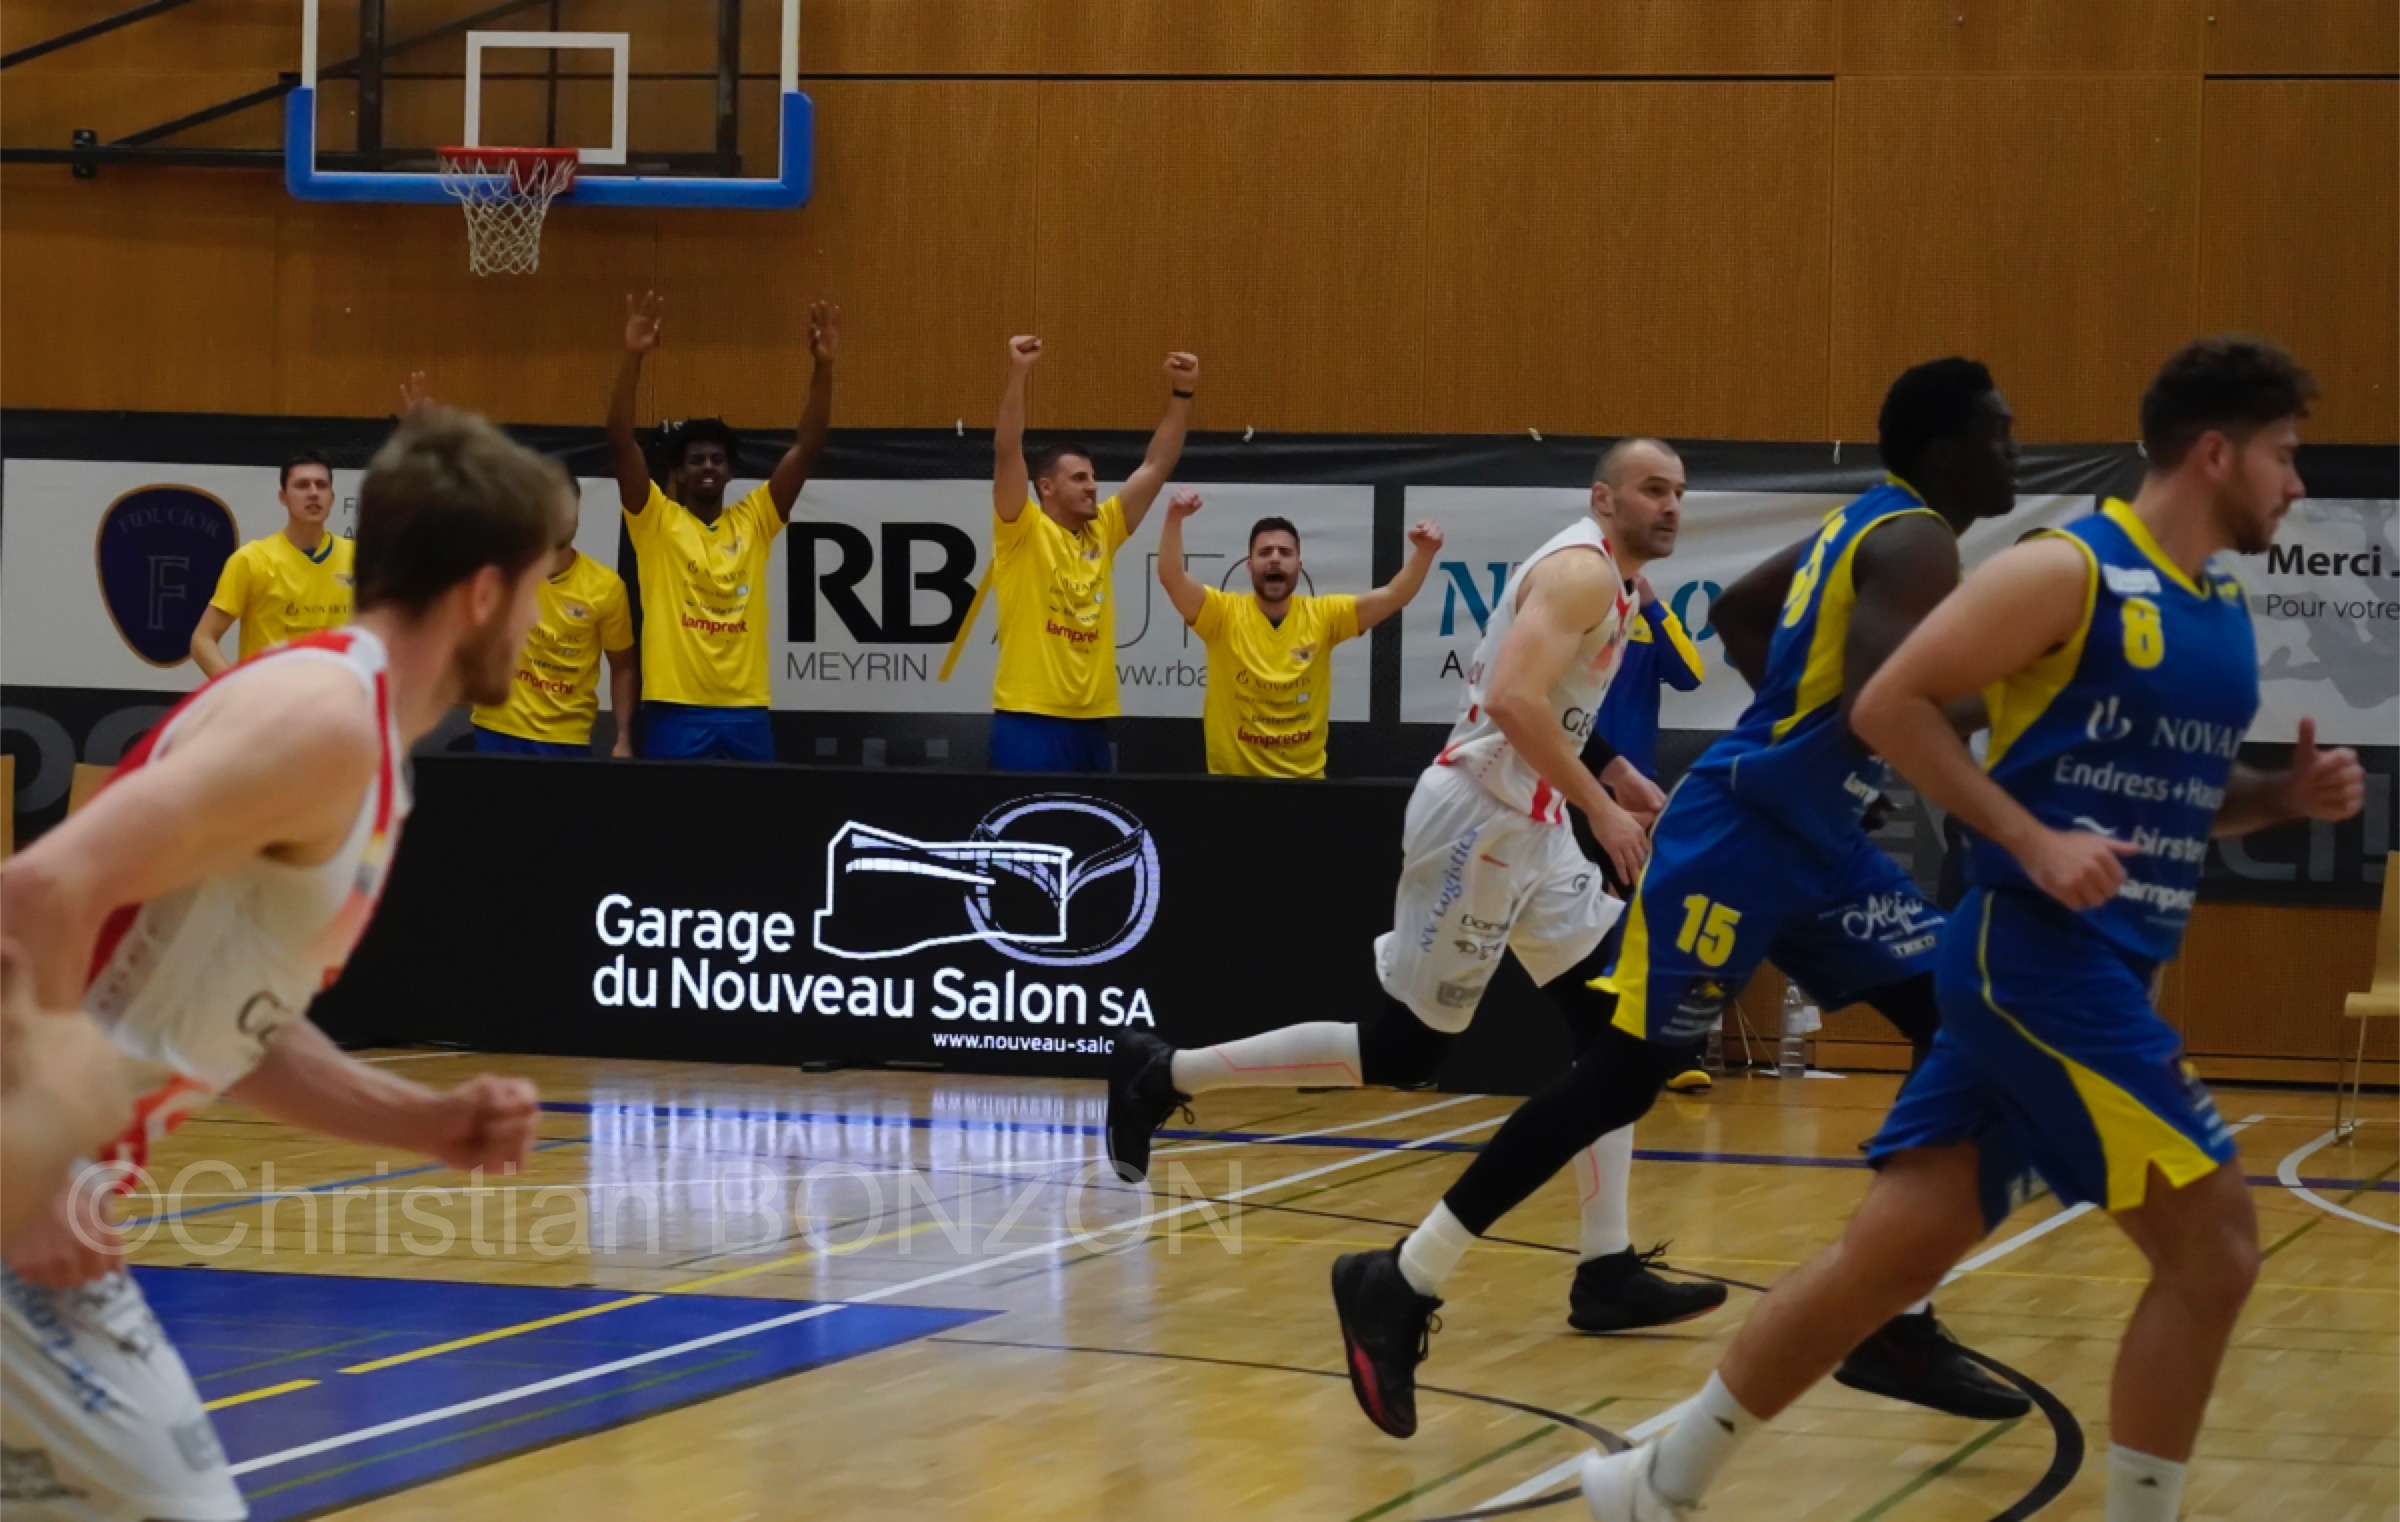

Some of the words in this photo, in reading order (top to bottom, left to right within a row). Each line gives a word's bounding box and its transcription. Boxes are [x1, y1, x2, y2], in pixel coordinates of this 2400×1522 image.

[116, 506, 220, 539] FIDUCIOR
[787, 521, 977, 644] RB
[2267, 543, 2381, 578] Merci
[2120, 597, 2165, 669] 8
[2266, 593, 2325, 619] Pour
[2333, 597, 2400, 620] votre
[786, 651, 928, 683] MEYRIN
[595, 893, 796, 965] Garage
[1675, 893, 1742, 967] 15
[592, 953, 658, 1008] du
[670, 956, 915, 1019] Nouveau
[930, 966, 1087, 1025] Salon
[1098, 986, 1156, 1028] SA
